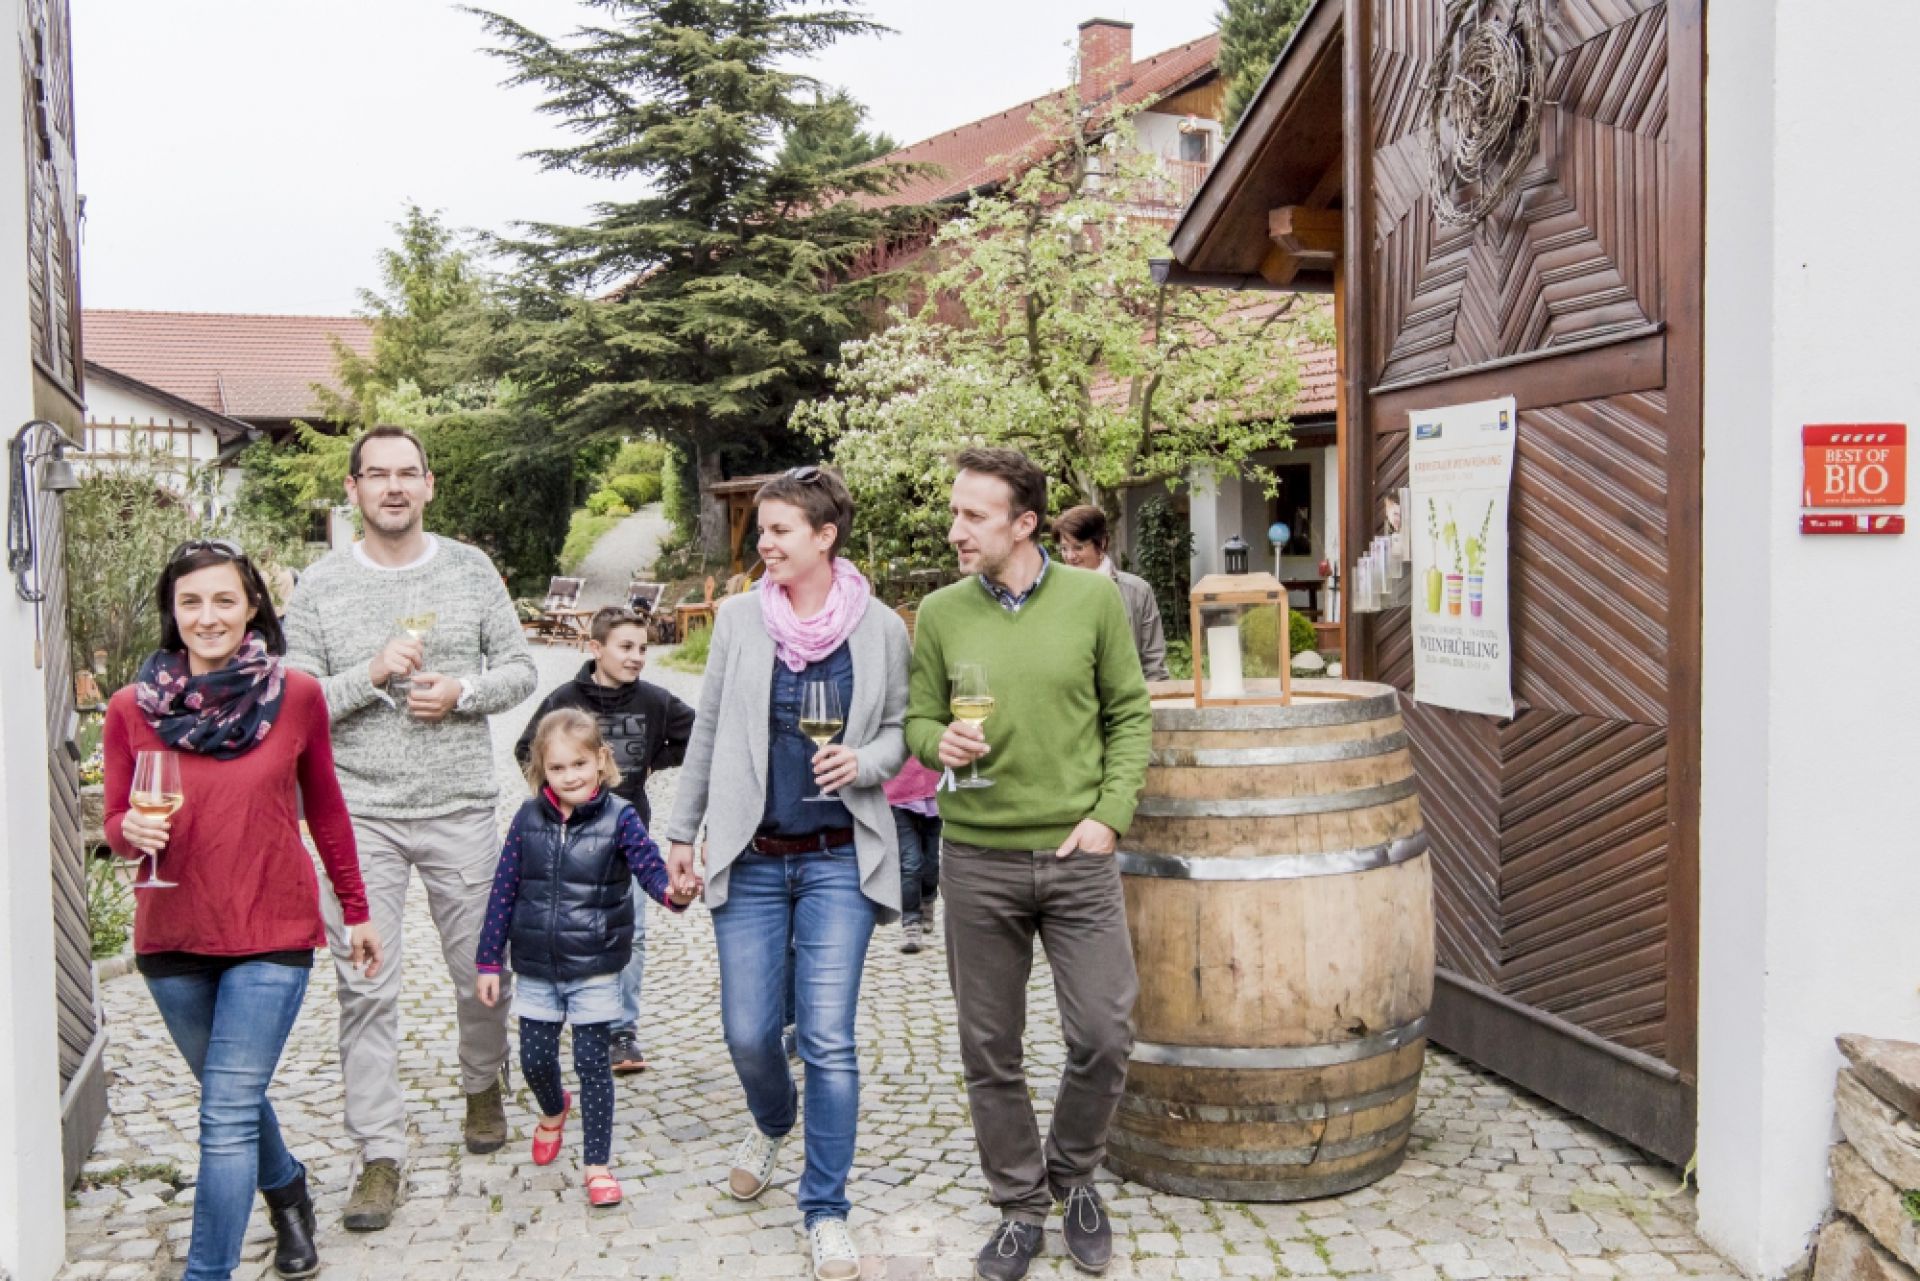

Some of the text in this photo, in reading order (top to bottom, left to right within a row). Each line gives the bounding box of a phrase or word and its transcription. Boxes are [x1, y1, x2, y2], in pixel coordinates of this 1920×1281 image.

[1825, 448, 1889, 462] BEST OF
[1823, 464, 1889, 494] BIO
